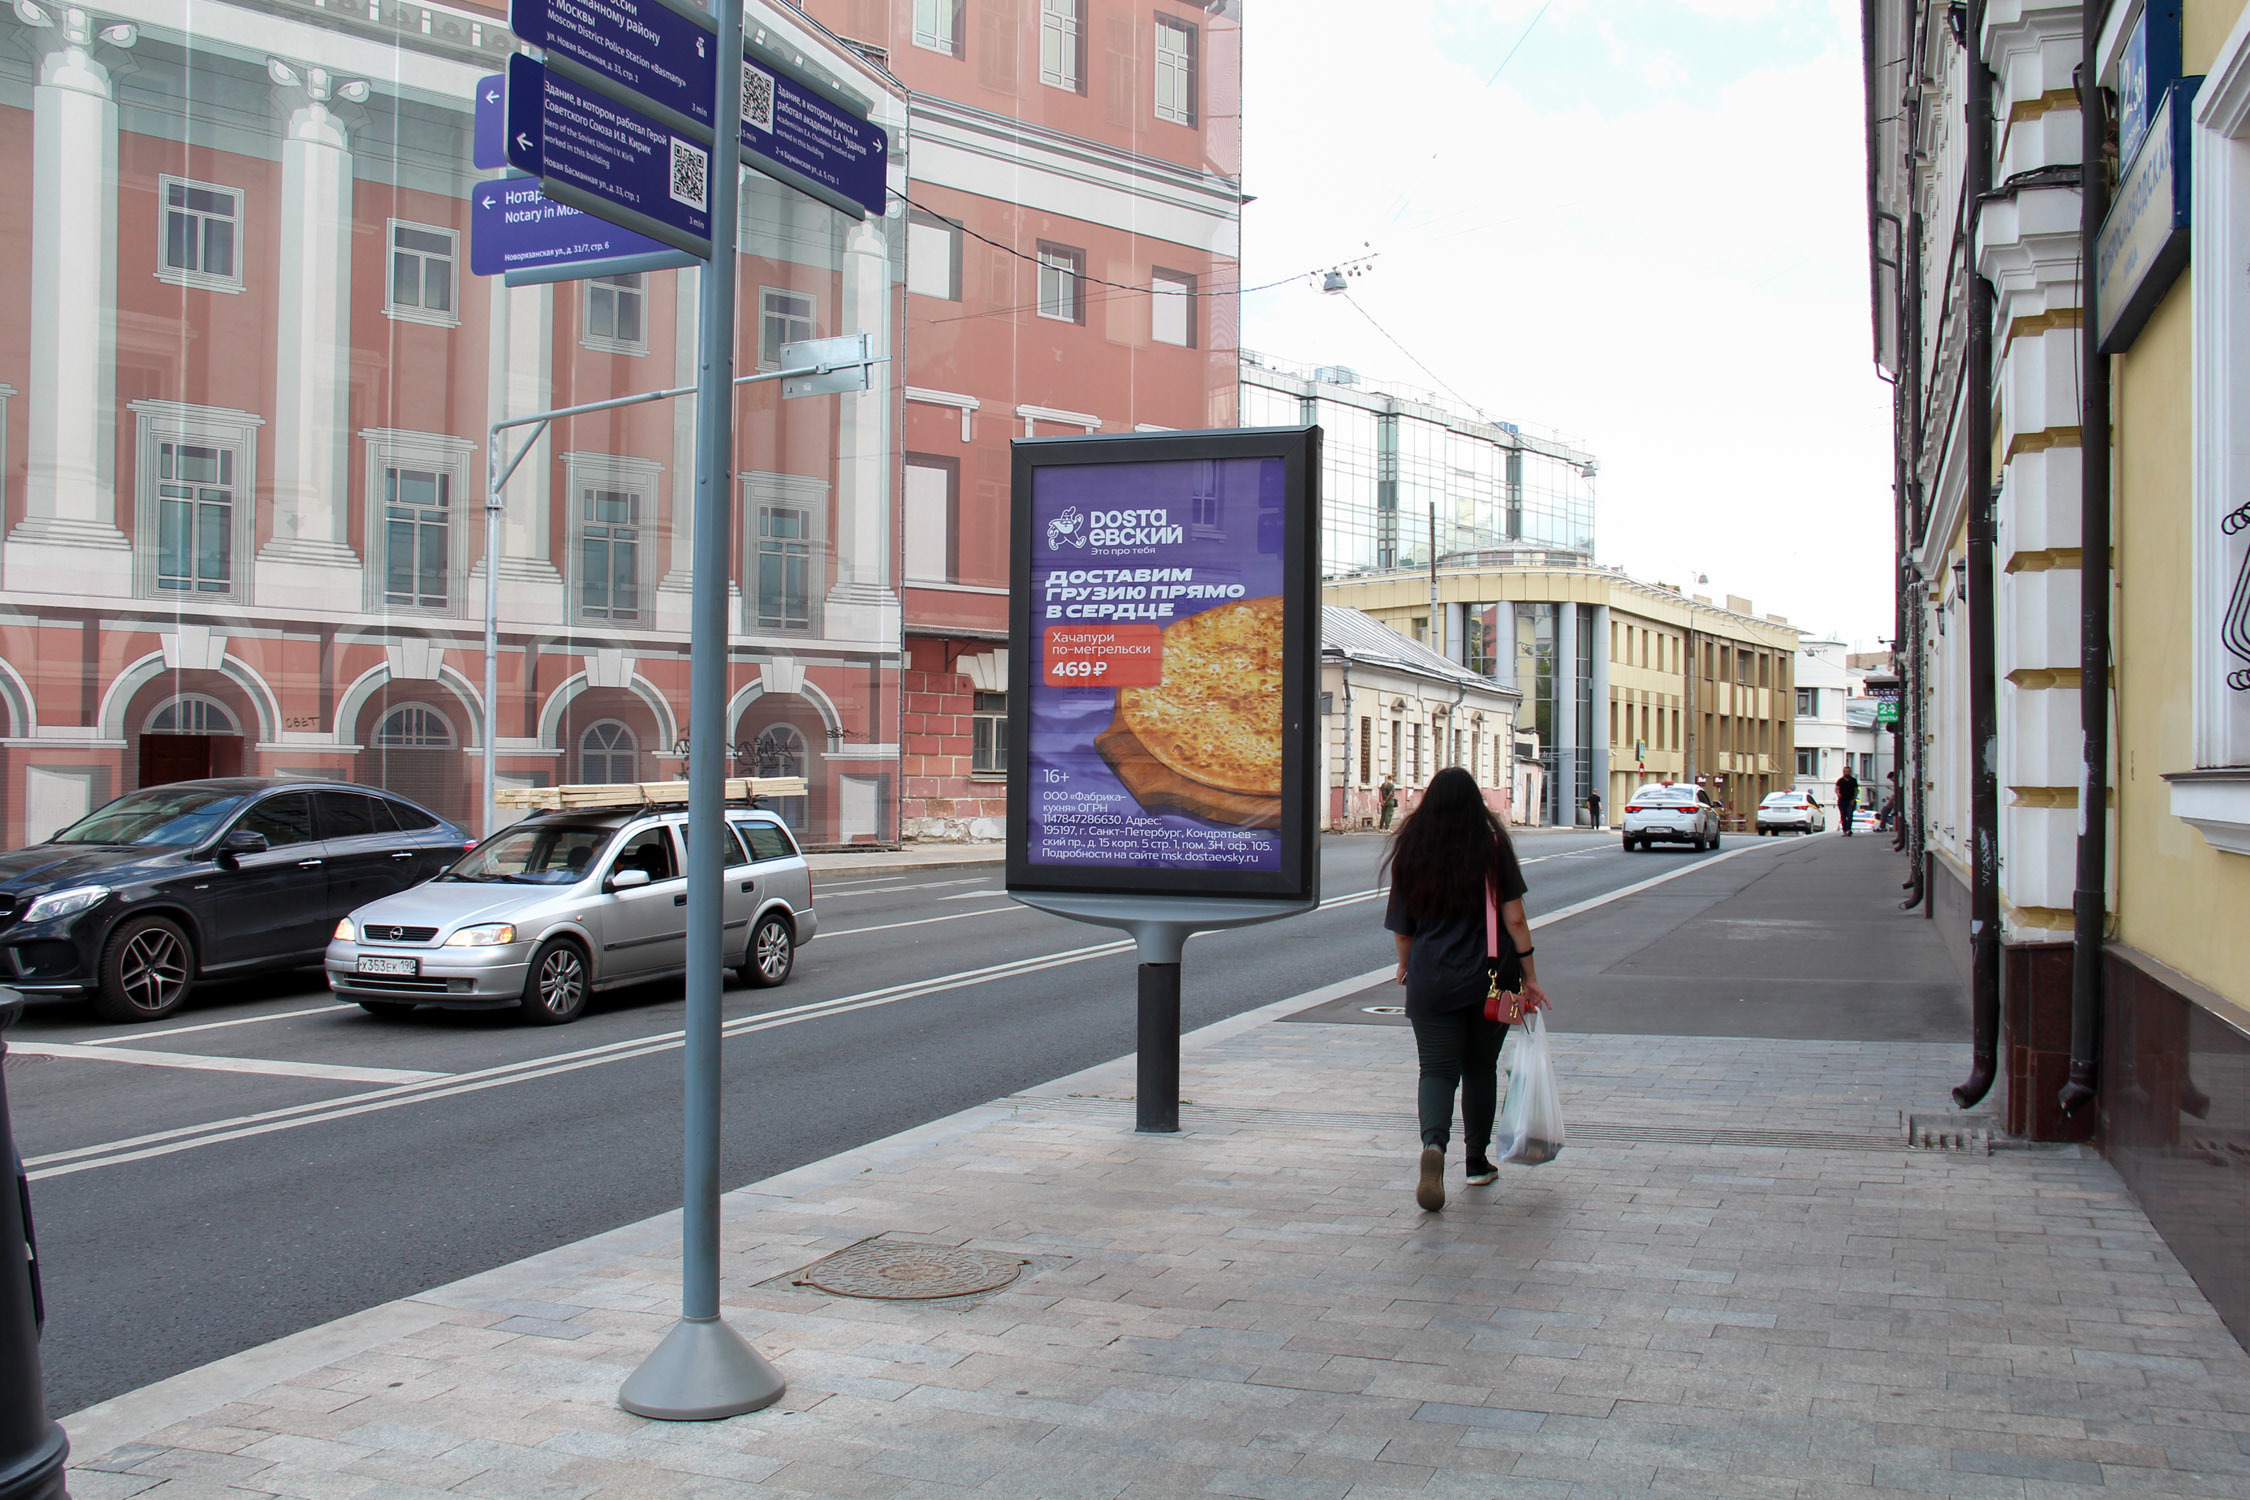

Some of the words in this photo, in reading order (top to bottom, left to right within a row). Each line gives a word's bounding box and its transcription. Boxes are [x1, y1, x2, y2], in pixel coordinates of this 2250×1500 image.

[556, 0, 596, 27] Москвы
[626, 18, 661, 47] району
[546, 31, 556, 42] ул.
[556, 35, 577, 52] Новая
[613, 62, 623, 77] 33,
[622, 68, 634, 82] стр.
[547, 9, 577, 32] Moscow
[577, 24, 604, 46] District
[604, 38, 625, 57] Police
[625, 48, 650, 69] Station
[651, 63, 687, 88] «Basmany»
[691, 102, 697, 112] 3
[696, 106, 709, 118] min
[777, 83, 802, 107] Здание,
[806, 101, 834, 123] котором
[544, 80, 576, 107] Здание,
[576, 97, 582, 108] в
[582, 99, 616, 123] котором
[616, 115, 646, 138] работал
[646, 128, 668, 147] Герой
[777, 100, 803, 121] работал
[802, 114, 833, 137] академик
[544, 98, 588, 127] Советского
[588, 118, 613, 139] Союза
[613, 130, 628, 146] И.В.
[628, 138, 652, 156] Кирик
[544, 117, 559, 131] Hero
[559, 124, 567, 134] of
[566, 127, 577, 140] the
[577, 132, 596, 149] Soviet
[596, 141, 614, 156] Union
[621, 151, 635, 165] Kirik
[544, 134, 567, 150] worked
[573, 145, 586, 159] this
[585, 149, 611, 170] building
[544, 155, 564, 172] Новая
[564, 164, 599, 187] Басманная
[615, 184, 625, 198] 33,
[624, 190, 636, 204] стр.
[504, 209, 541, 225] Notary
[542, 205, 555, 219] in
[688, 215, 694, 226] 3
[693, 218, 705, 230] min
[504, 248, 554, 262] Новорязанская
[554, 247, 566, 258] ул.,
[573, 243, 590, 253] 31/7,
[590, 242, 604, 253] стр.
[604, 241, 610, 249] 6
[1091, 547, 1110, 556] Это
[1111, 547, 1129, 557] про
[1133, 547, 1156, 555] тебя
[1045, 567, 1193, 588] ДОСТАВИМ
[1045, 586, 1147, 601] ГРУЗИЮ
[1150, 584, 1246, 599] ПРЯМО
[1046, 605, 1062, 618] В
[1065, 603, 1175, 621] СЕРДЦЕ
[1052, 631, 1115, 646] Хачапури
[1052, 645, 1151, 656] по-мегрельски
[1043, 769, 1070, 783] 16+
[1043, 791, 1068, 801] ООО
[1070, 791, 1127, 803] «Фабрика-
[1043, 804, 1075, 814] кухня»
[1078, 803, 1108, 812] ОГРН
[1043, 814, 1124, 825] 1147847286630.
[1125, 816, 1162, 827] Адрес:
[1043, 826, 1078, 836] 195197,
[1079, 827, 1087, 836] г.
[1088, 826, 1184, 839] Санкт-Петербург,
[1186, 828, 1257, 840] Кондратьев-
[1042, 837, 1066, 846] ский
[1067, 839, 1086, 848] пр.,
[1087, 839, 1097, 848] д.
[1099, 838, 1110, 848] 15
[1111, 840, 1140, 850] корп.
[1141, 839, 1149, 848] 5
[1150, 840, 1171, 850] стр.
[1172, 840, 1181, 850] 1,
[1182, 841, 1206, 850] пом.
[1207, 840, 1226, 851] 3Н,
[1227, 841, 1249, 853] оф.
[1250, 841, 1273, 852] 105.
[1042, 848, 1112, 859] Подробности
[1128, 850, 1159, 860] сайте
[1161, 851, 1259, 864] msk.dostaevsky.ru
